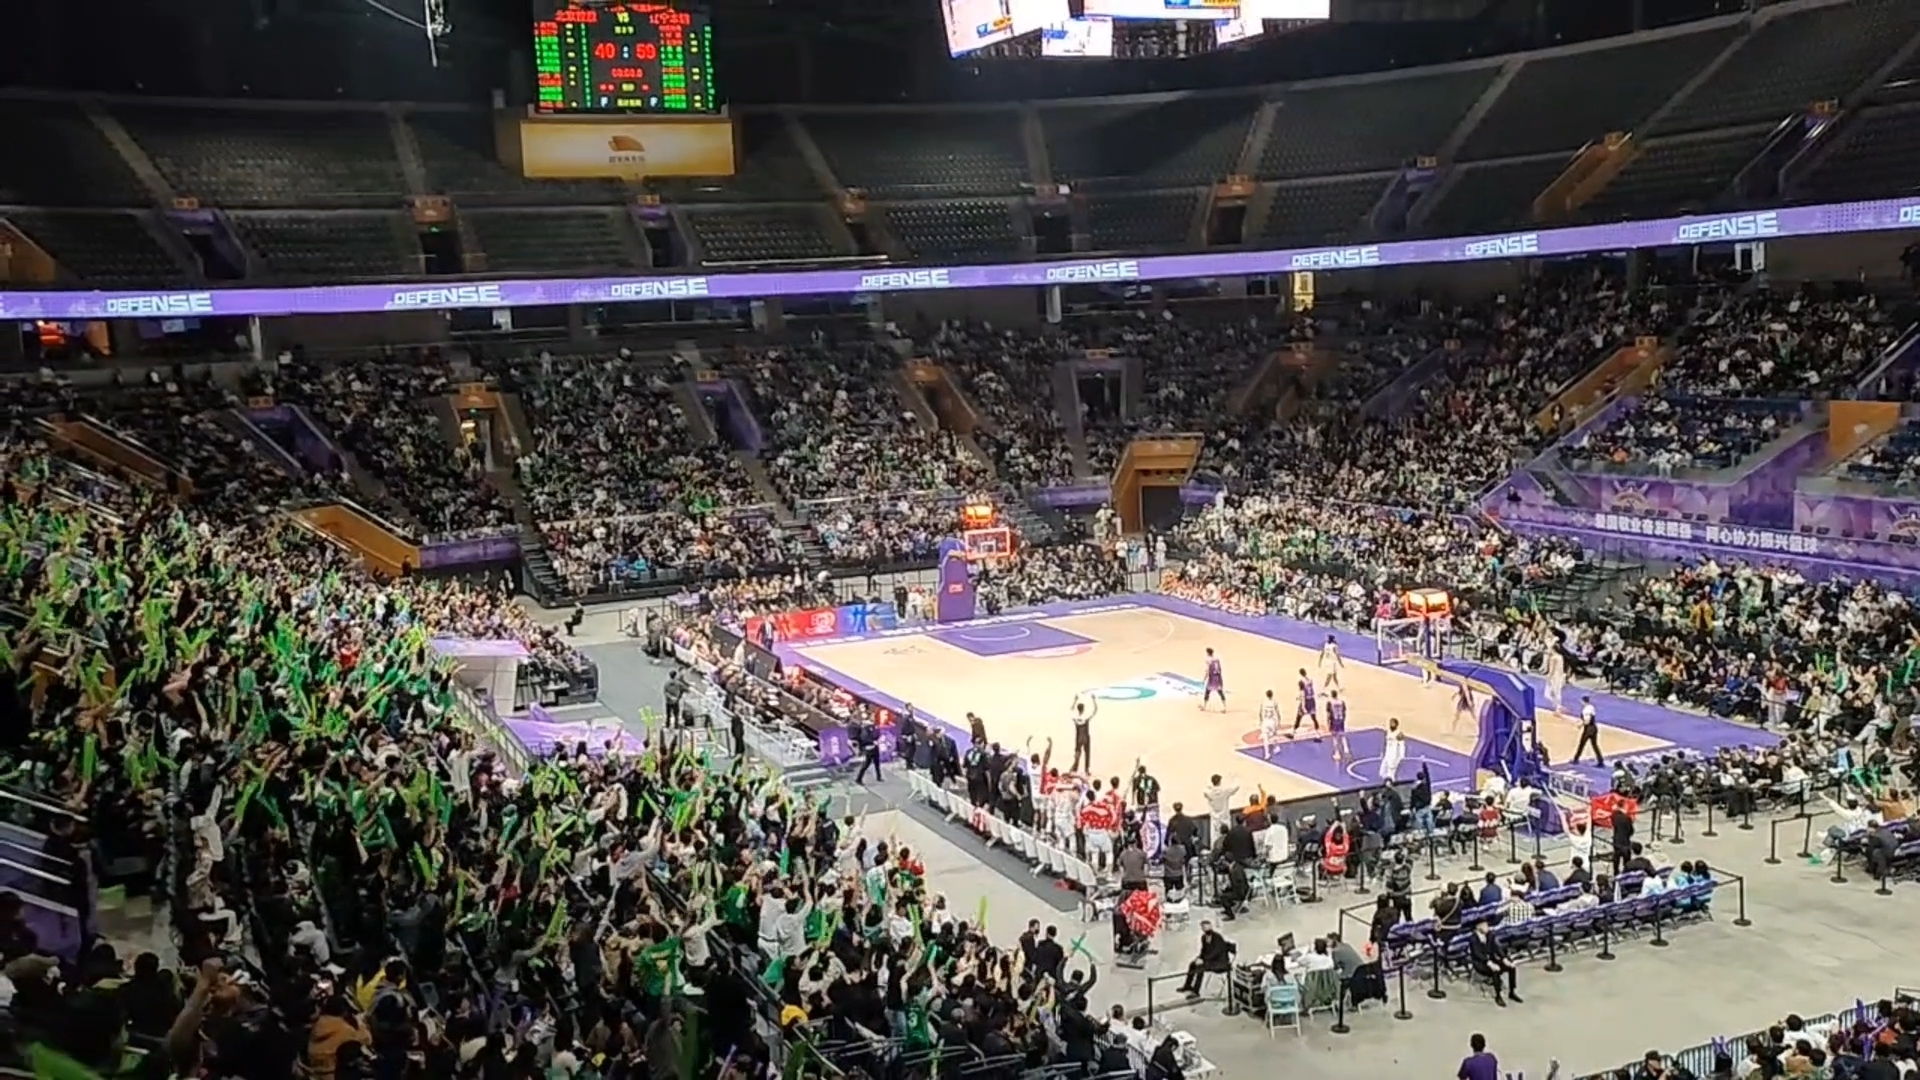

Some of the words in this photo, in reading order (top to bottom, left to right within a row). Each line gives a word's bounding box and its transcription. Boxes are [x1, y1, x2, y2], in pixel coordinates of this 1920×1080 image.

[616, 12, 630, 23] VS
[594, 43, 616, 58] 40
[1679, 212, 1778, 239] DEFENSE
[1465, 234, 1538, 256] DEFENSE
[1292, 246, 1380, 267] DEFENSE
[861, 269, 949, 288] DEFENSE
[1046, 261, 1139, 280] DEFENSE
[394, 285, 500, 305] DEFENSE
[612, 277, 708, 297] DEFENSE
[107, 292, 213, 313] DEFENSE
